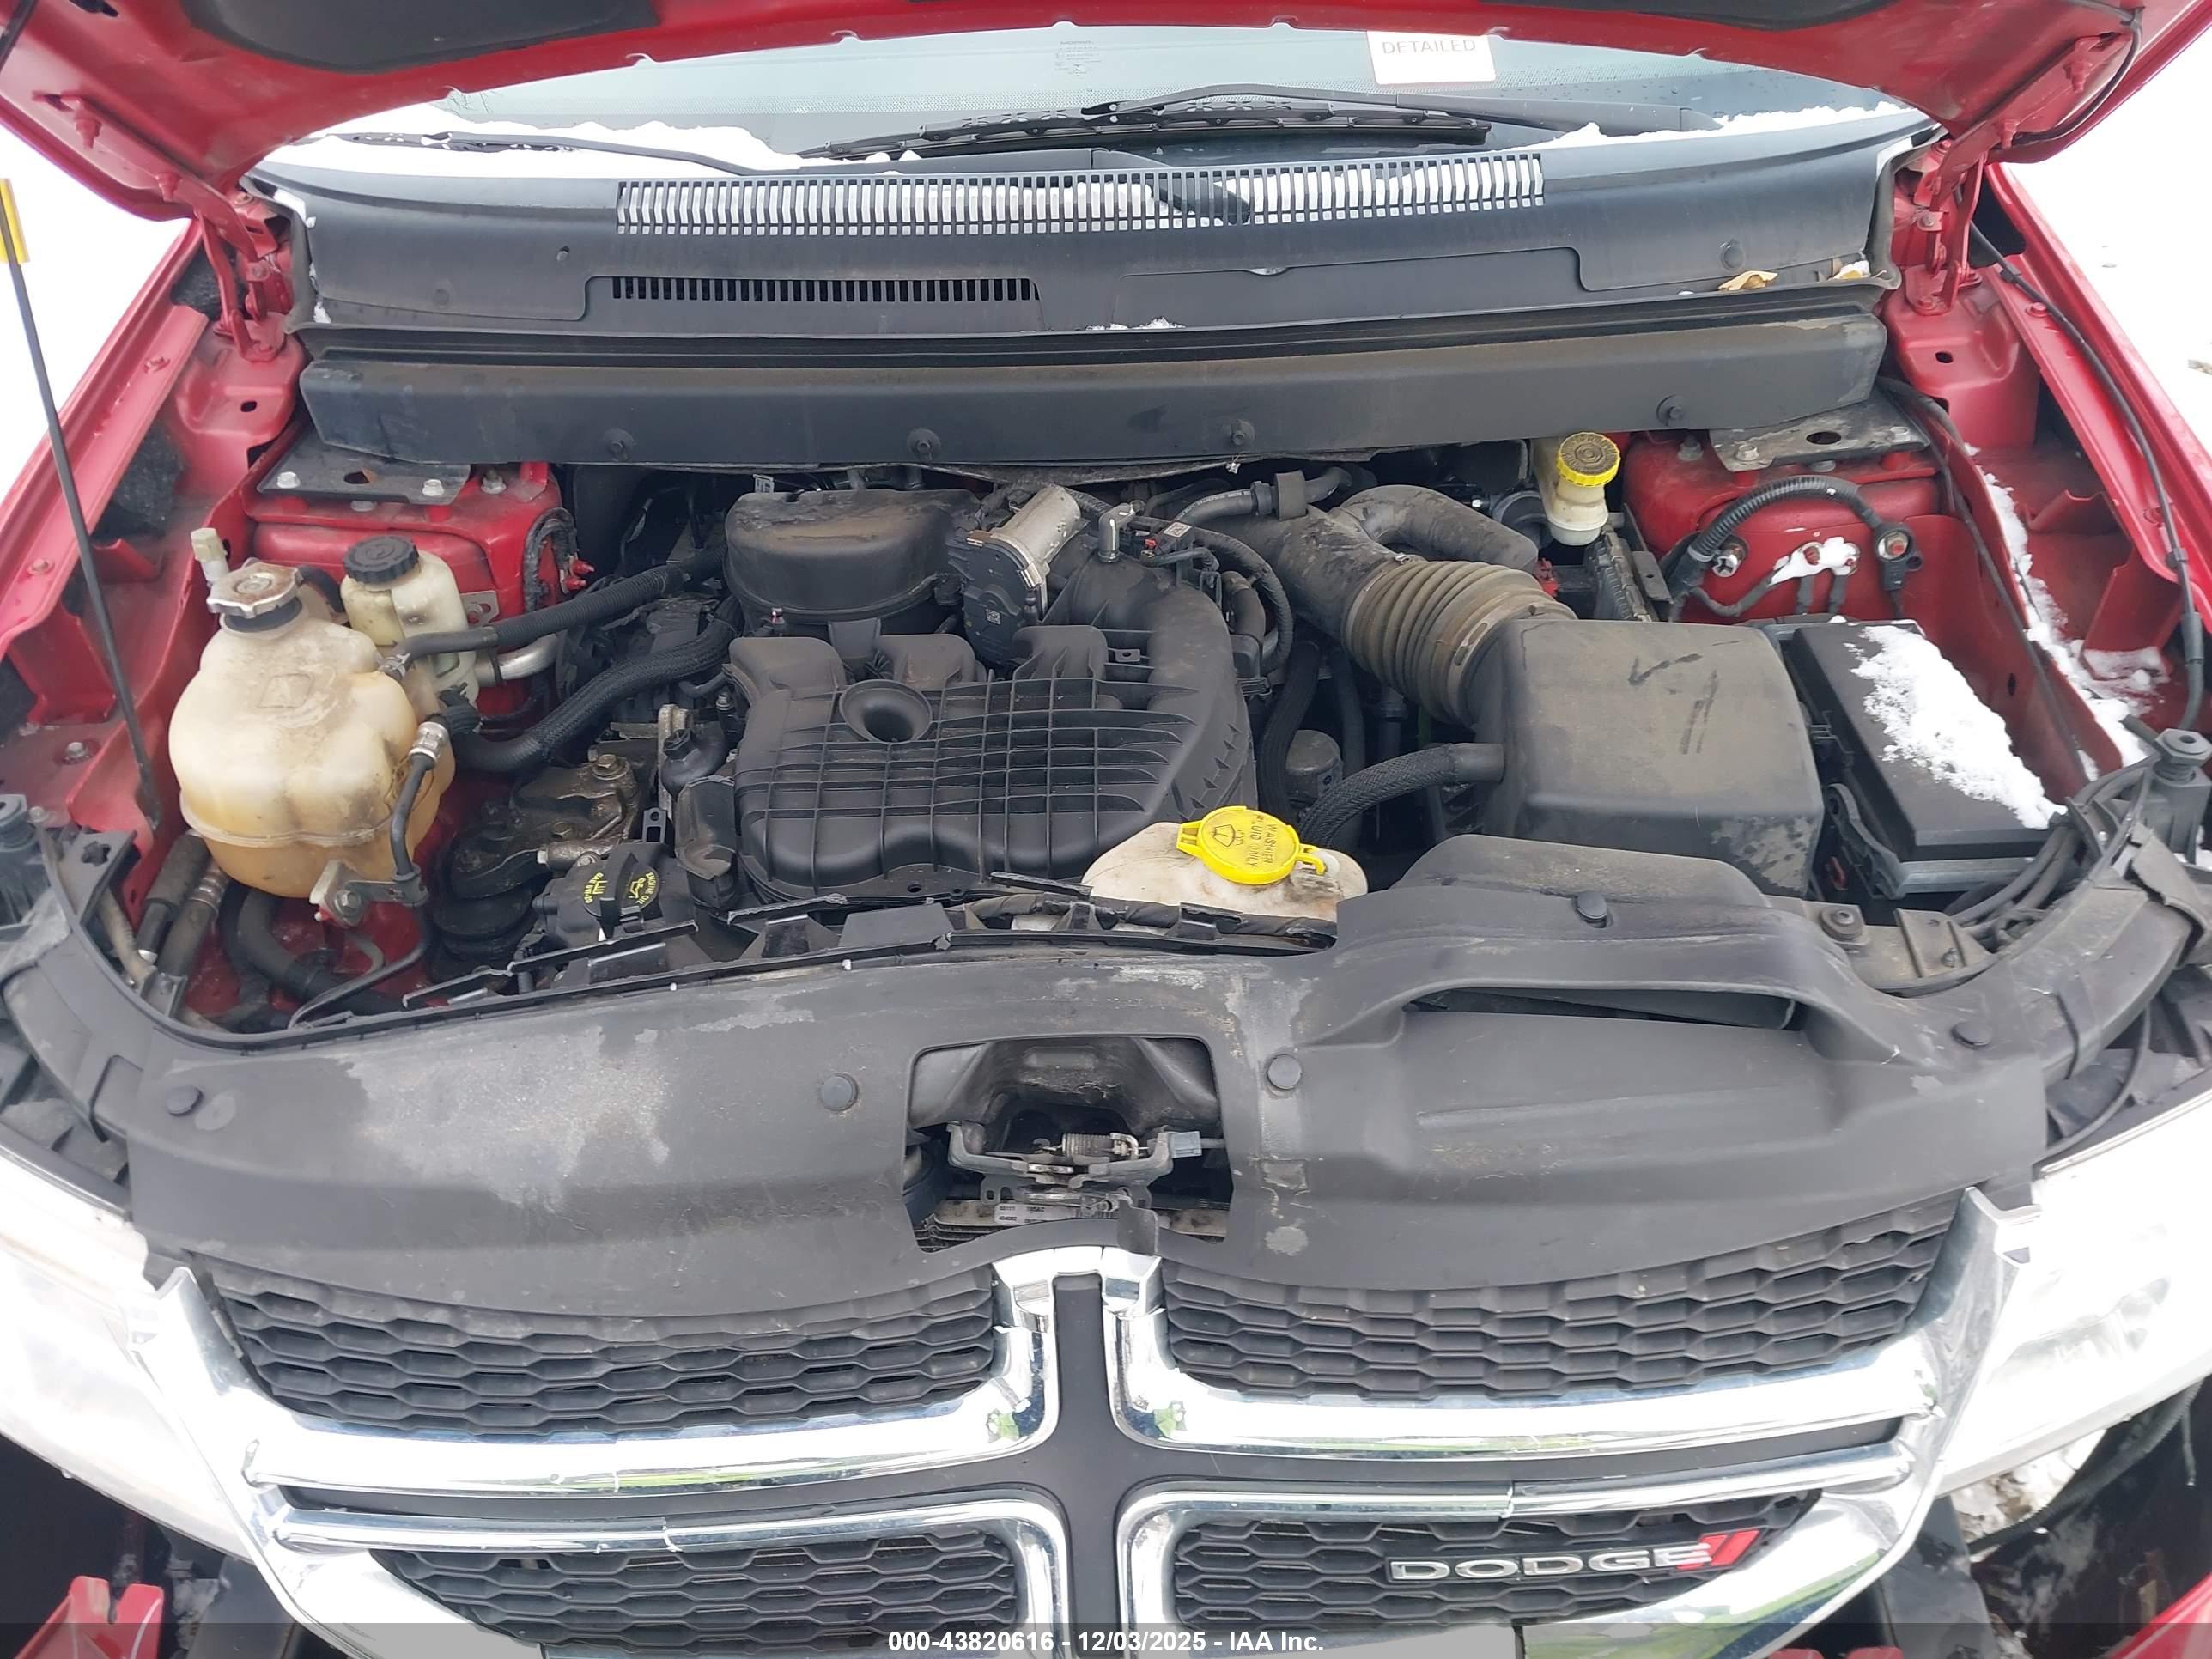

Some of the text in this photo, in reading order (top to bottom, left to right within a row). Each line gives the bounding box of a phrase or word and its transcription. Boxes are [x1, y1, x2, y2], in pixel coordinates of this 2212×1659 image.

[1382, 39, 1476, 54] DETAILED
[1245, 815, 1265, 867] FLUID ONLY
[1262, 824, 1279, 864] WASHER
[635, 872, 657, 905] ENGINE OIL
[1390, 1542, 1712, 1581] DODGE
